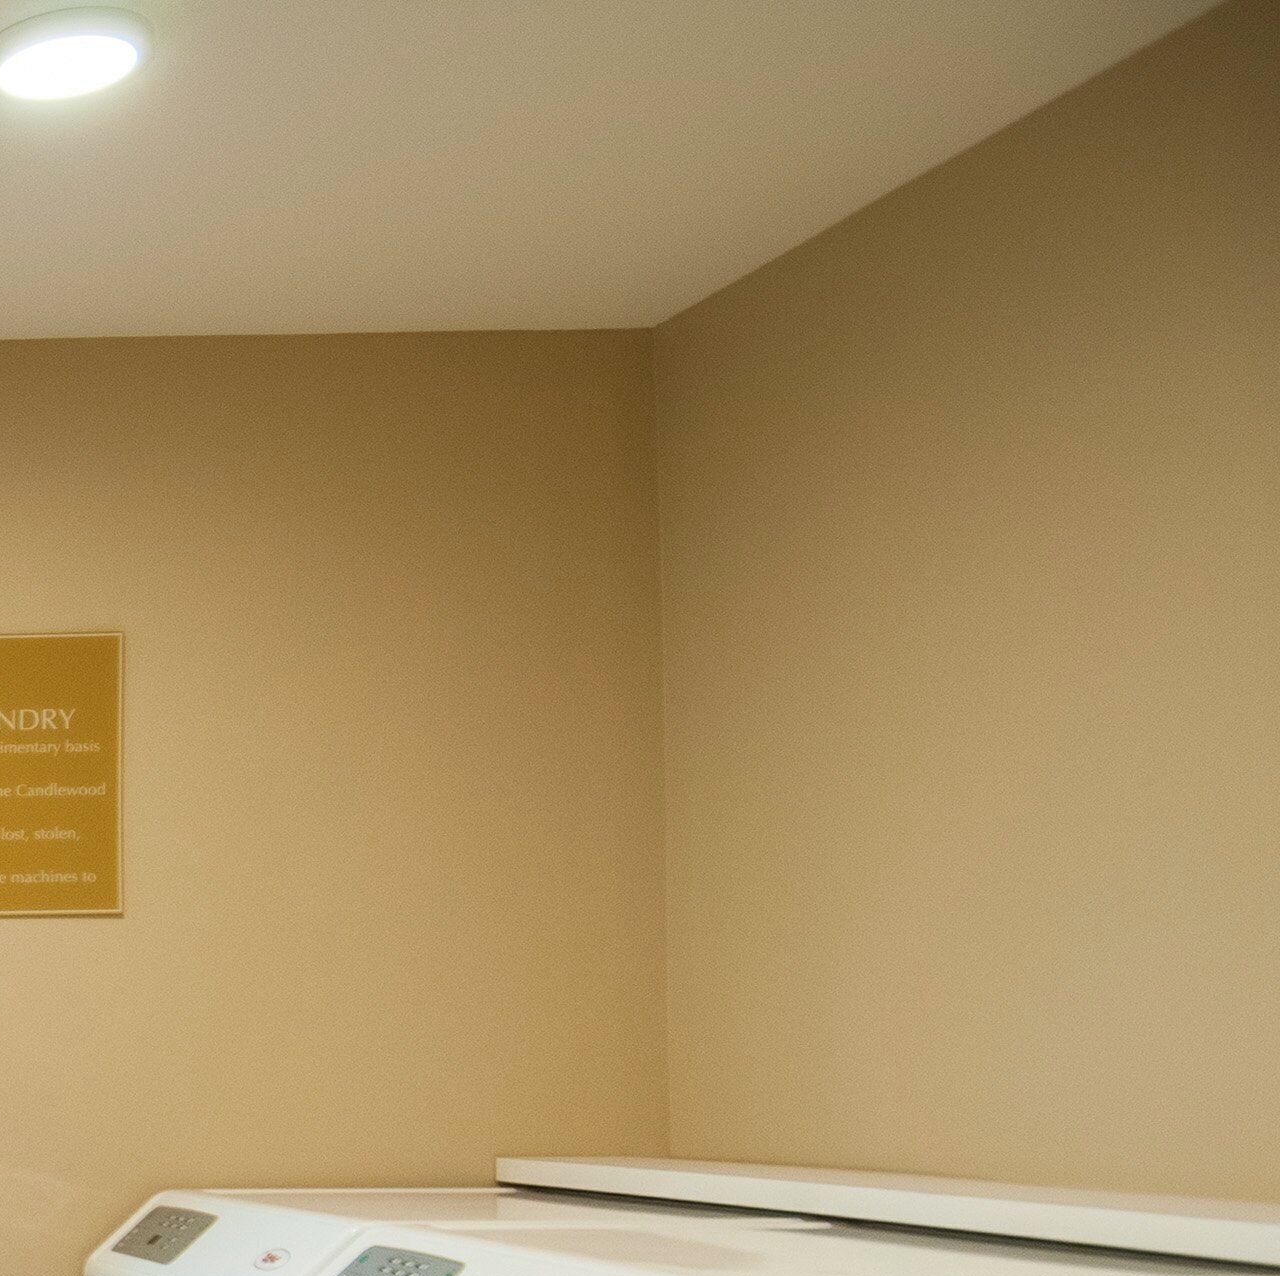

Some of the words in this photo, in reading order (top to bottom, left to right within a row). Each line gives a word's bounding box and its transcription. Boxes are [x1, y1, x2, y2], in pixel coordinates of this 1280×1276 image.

[65, 740, 100, 753] basis
[16, 782, 107, 796] Candlewood
[34, 827, 81, 841] stolen,
[10, 870, 78, 883] machines
[82, 870, 97, 882] to
